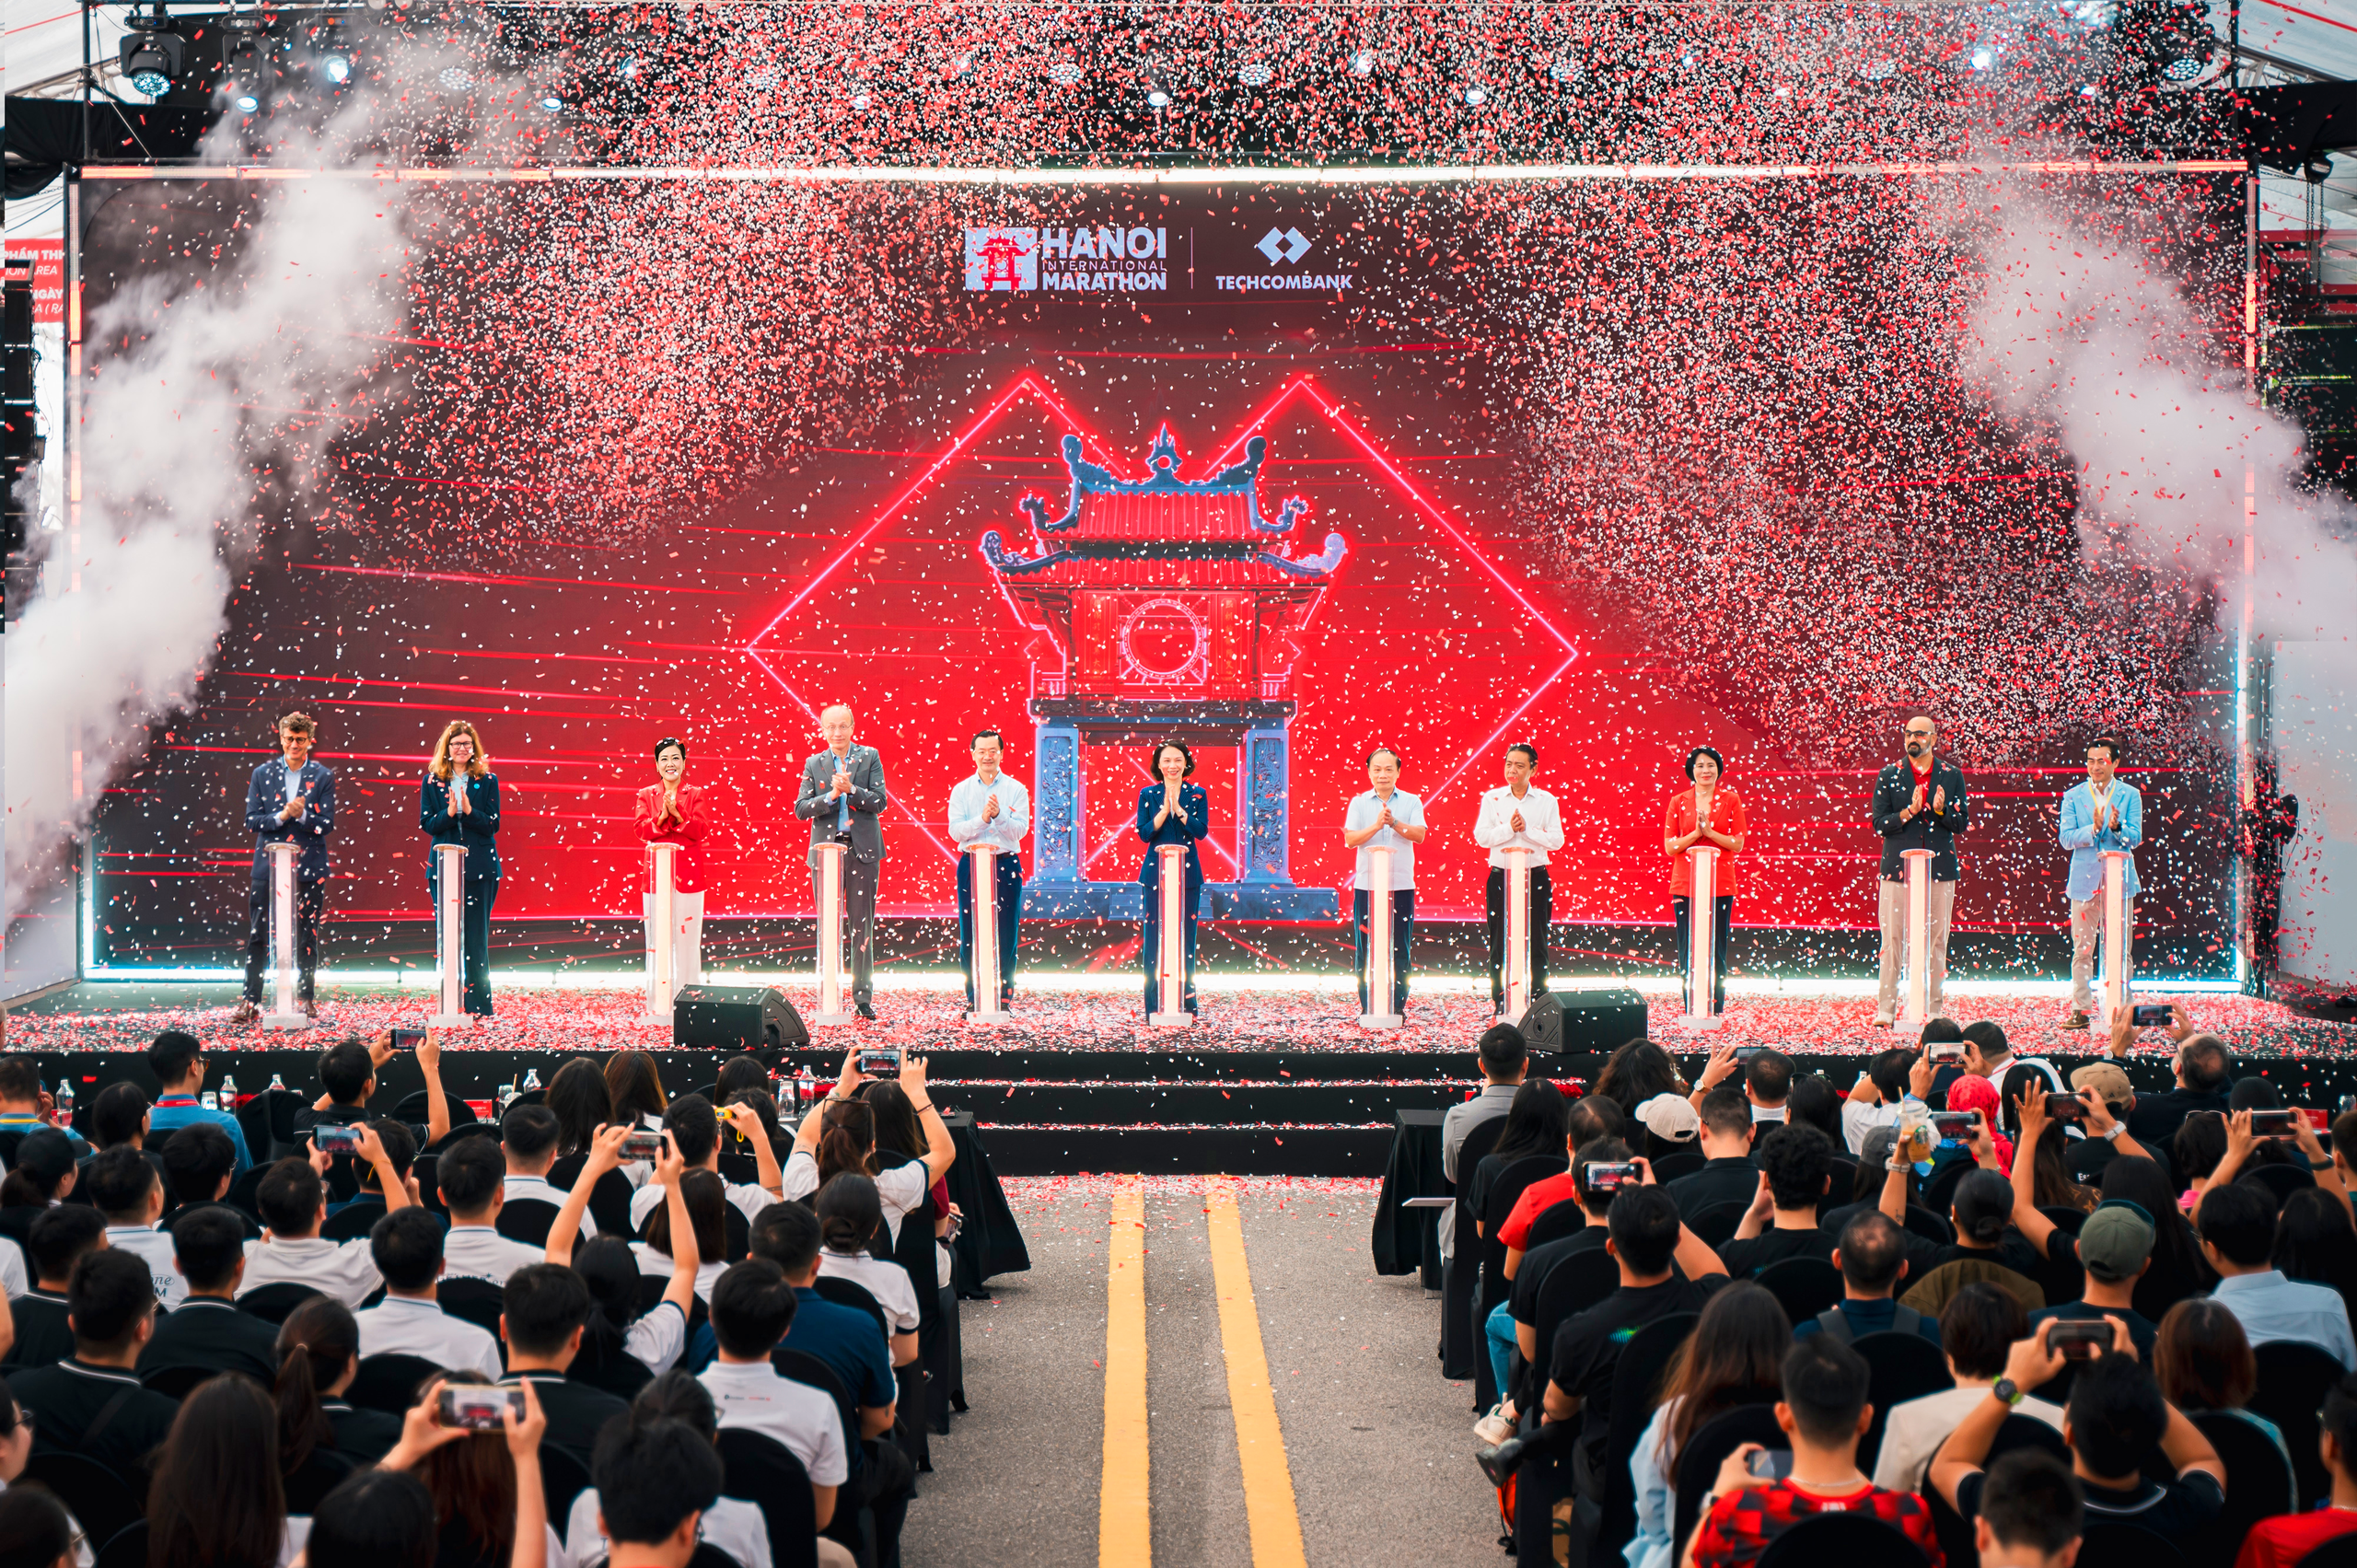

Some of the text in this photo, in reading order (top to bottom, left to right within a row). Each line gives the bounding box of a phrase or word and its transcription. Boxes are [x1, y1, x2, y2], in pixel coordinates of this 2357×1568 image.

[1042, 227, 1167, 259] HANOI
[34, 265, 58, 274] REA
[1042, 261, 1167, 271] INTERNATIONAL
[1042, 272, 1167, 290] MARATHON
[1215, 274, 1353, 290] TECHCOMBANK
